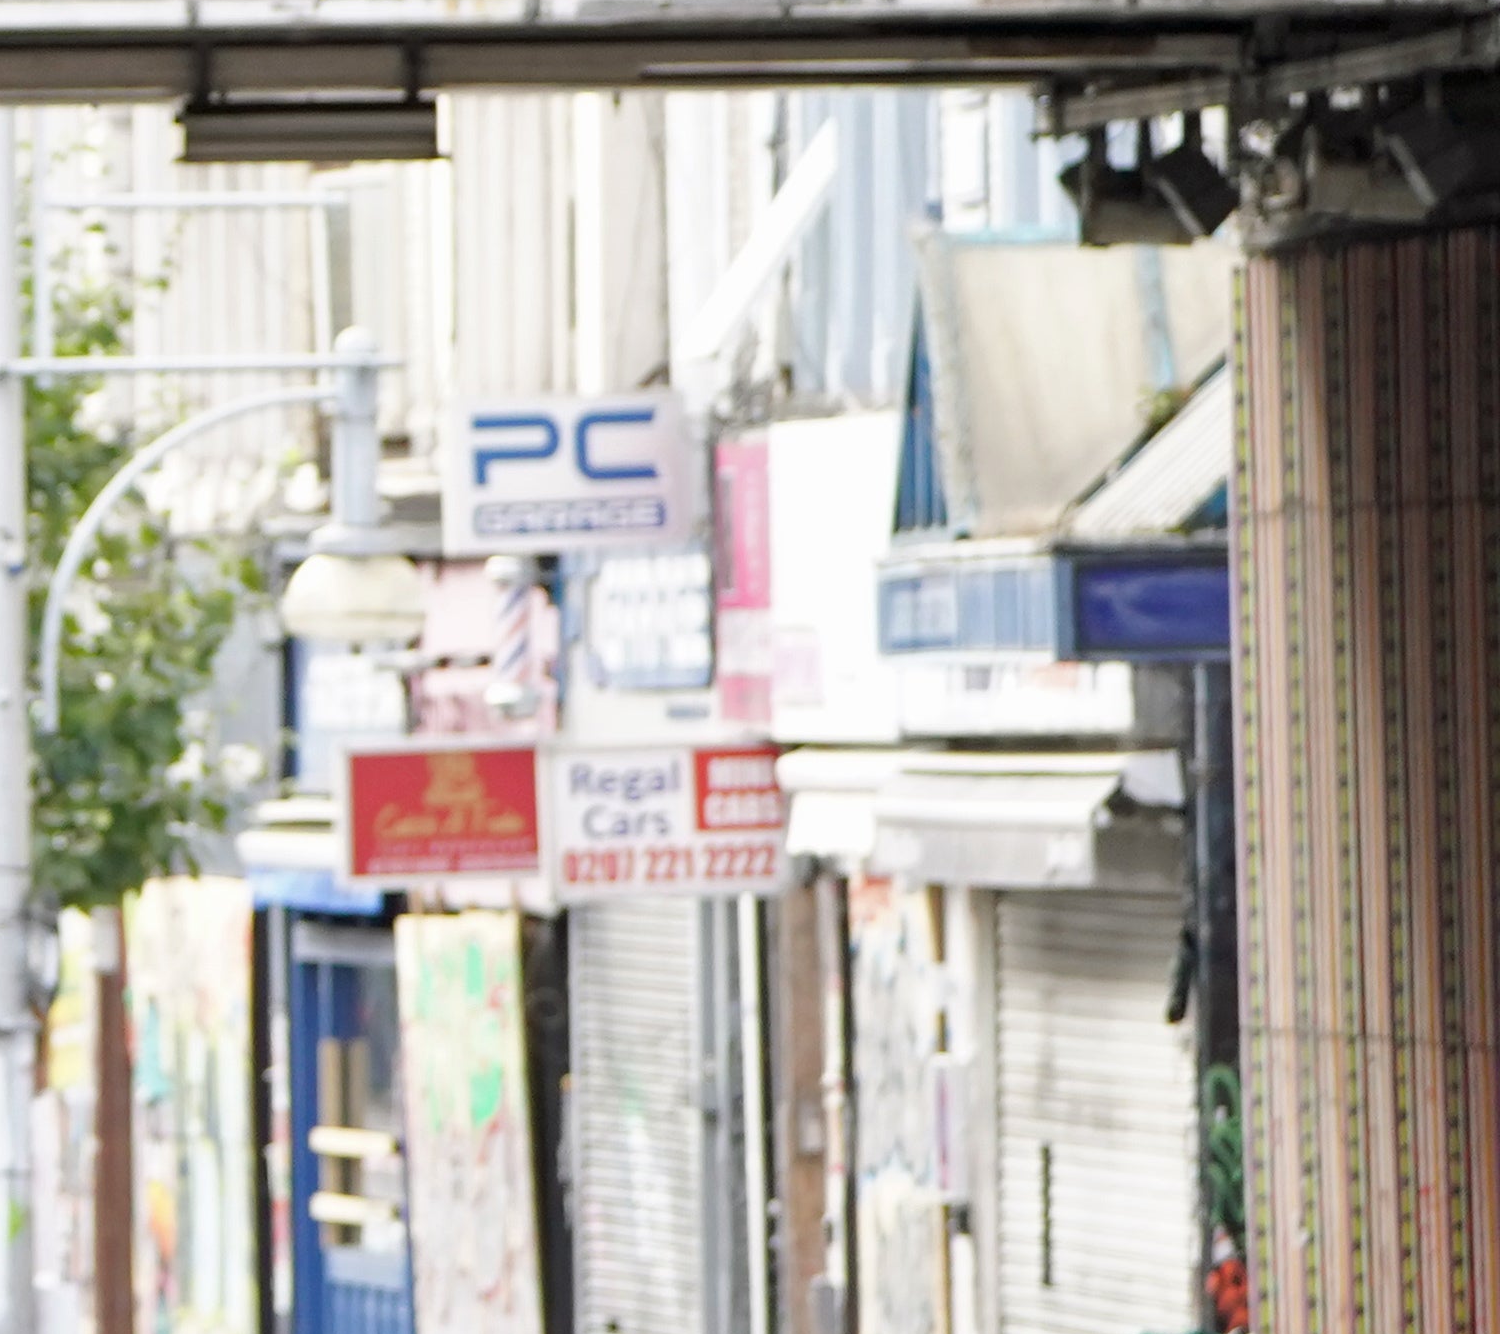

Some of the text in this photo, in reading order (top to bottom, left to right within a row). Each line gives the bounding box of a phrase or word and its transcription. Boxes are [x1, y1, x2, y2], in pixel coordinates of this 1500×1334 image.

[470, 405, 659, 486] PC
[568, 758, 682, 802] Regal
[581, 803, 671, 839] Cars
[644, 848, 696, 880] 221
[704, 844, 777, 878] 2222
